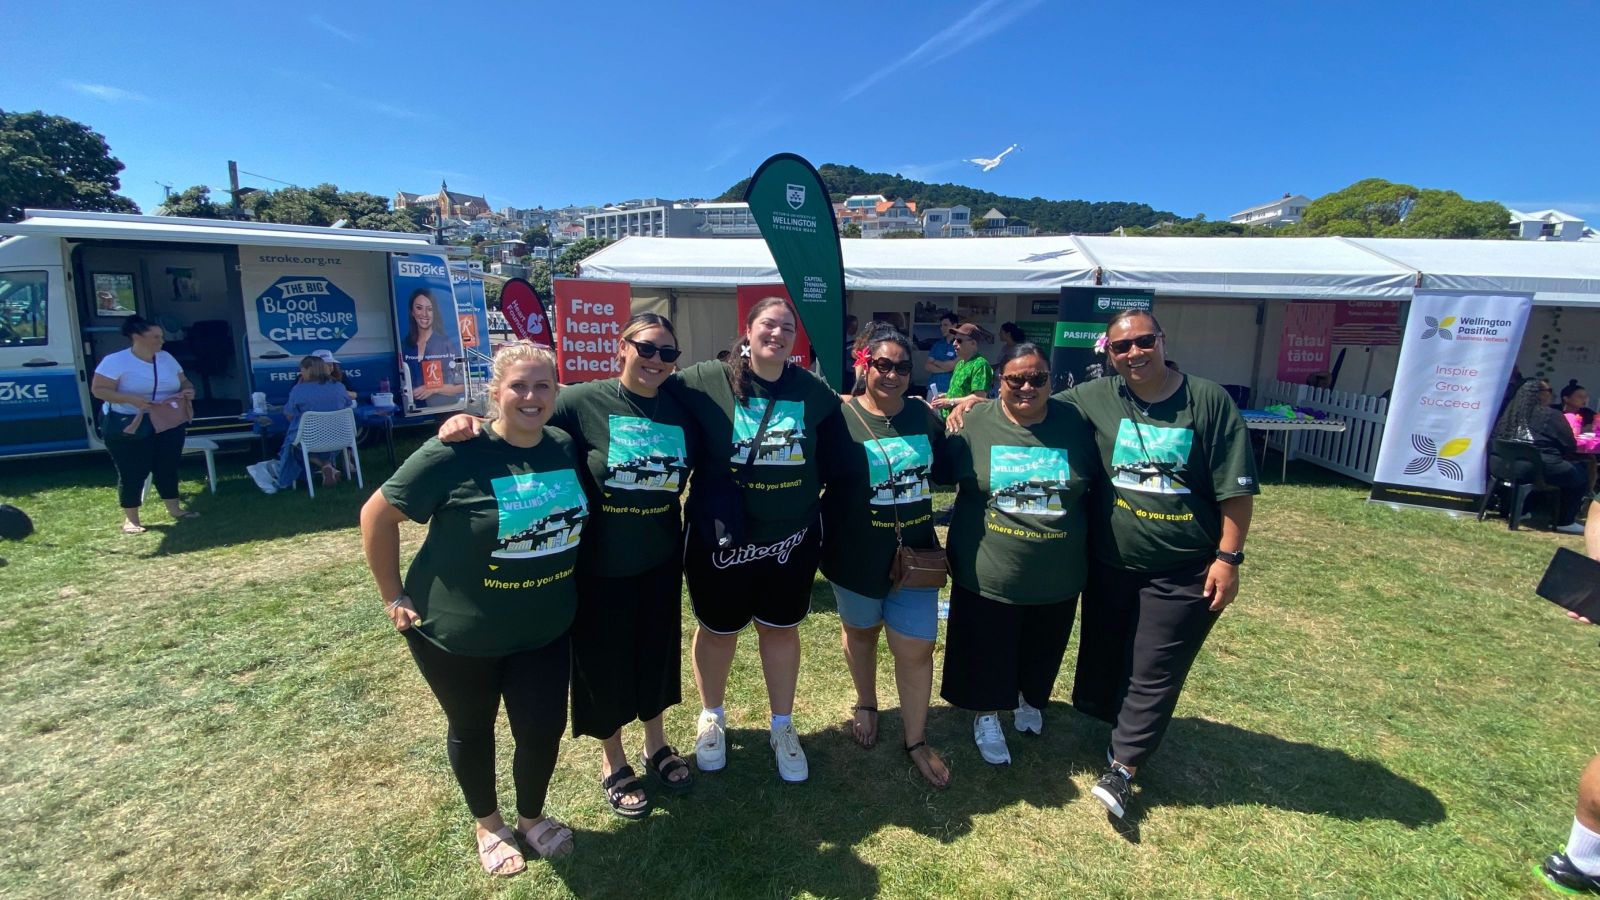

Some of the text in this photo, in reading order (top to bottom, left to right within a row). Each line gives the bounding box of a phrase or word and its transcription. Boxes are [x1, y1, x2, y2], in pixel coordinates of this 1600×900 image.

[772, 215, 817, 228] WELLINGTON
[259, 254, 342, 267] stroke.org.nz
[401, 263, 445, 276] STROKE
[284, 282, 324, 295] THE BIG
[511, 299, 526, 322] Heart
[571, 298, 615, 316] Free
[1111, 300, 1150, 308] WELLINGTON
[566, 317, 620, 335] heart
[1460, 317, 1512, 327] Wellington
[269, 327, 349, 341] CHECK
[1458, 326, 1498, 336] Pasifika
[1287, 333, 1325, 347] Tatau
[565, 355, 621, 373] check
[1435, 365, 1478, 377] Inspire
[1435, 381, 1472, 392] Grow
[1419, 396, 1480, 410] Succeed
[755, 481, 765, 490] do
[602, 504, 628, 514] Where
[629, 506, 640, 514] do
[1135, 509, 1147, 517] do
[1148, 512, 1165, 520] you
[1166, 513, 1194, 521] stand?
[871, 520, 895, 528] Where
[987, 522, 1012, 534] Where
[1025, 531, 1042, 539] you
[1042, 531, 1068, 539] stand?
[712, 527, 808, 569] Chicago
[484, 578, 520, 589] Where
[522, 580, 535, 589] do
[537, 575, 554, 588] you
